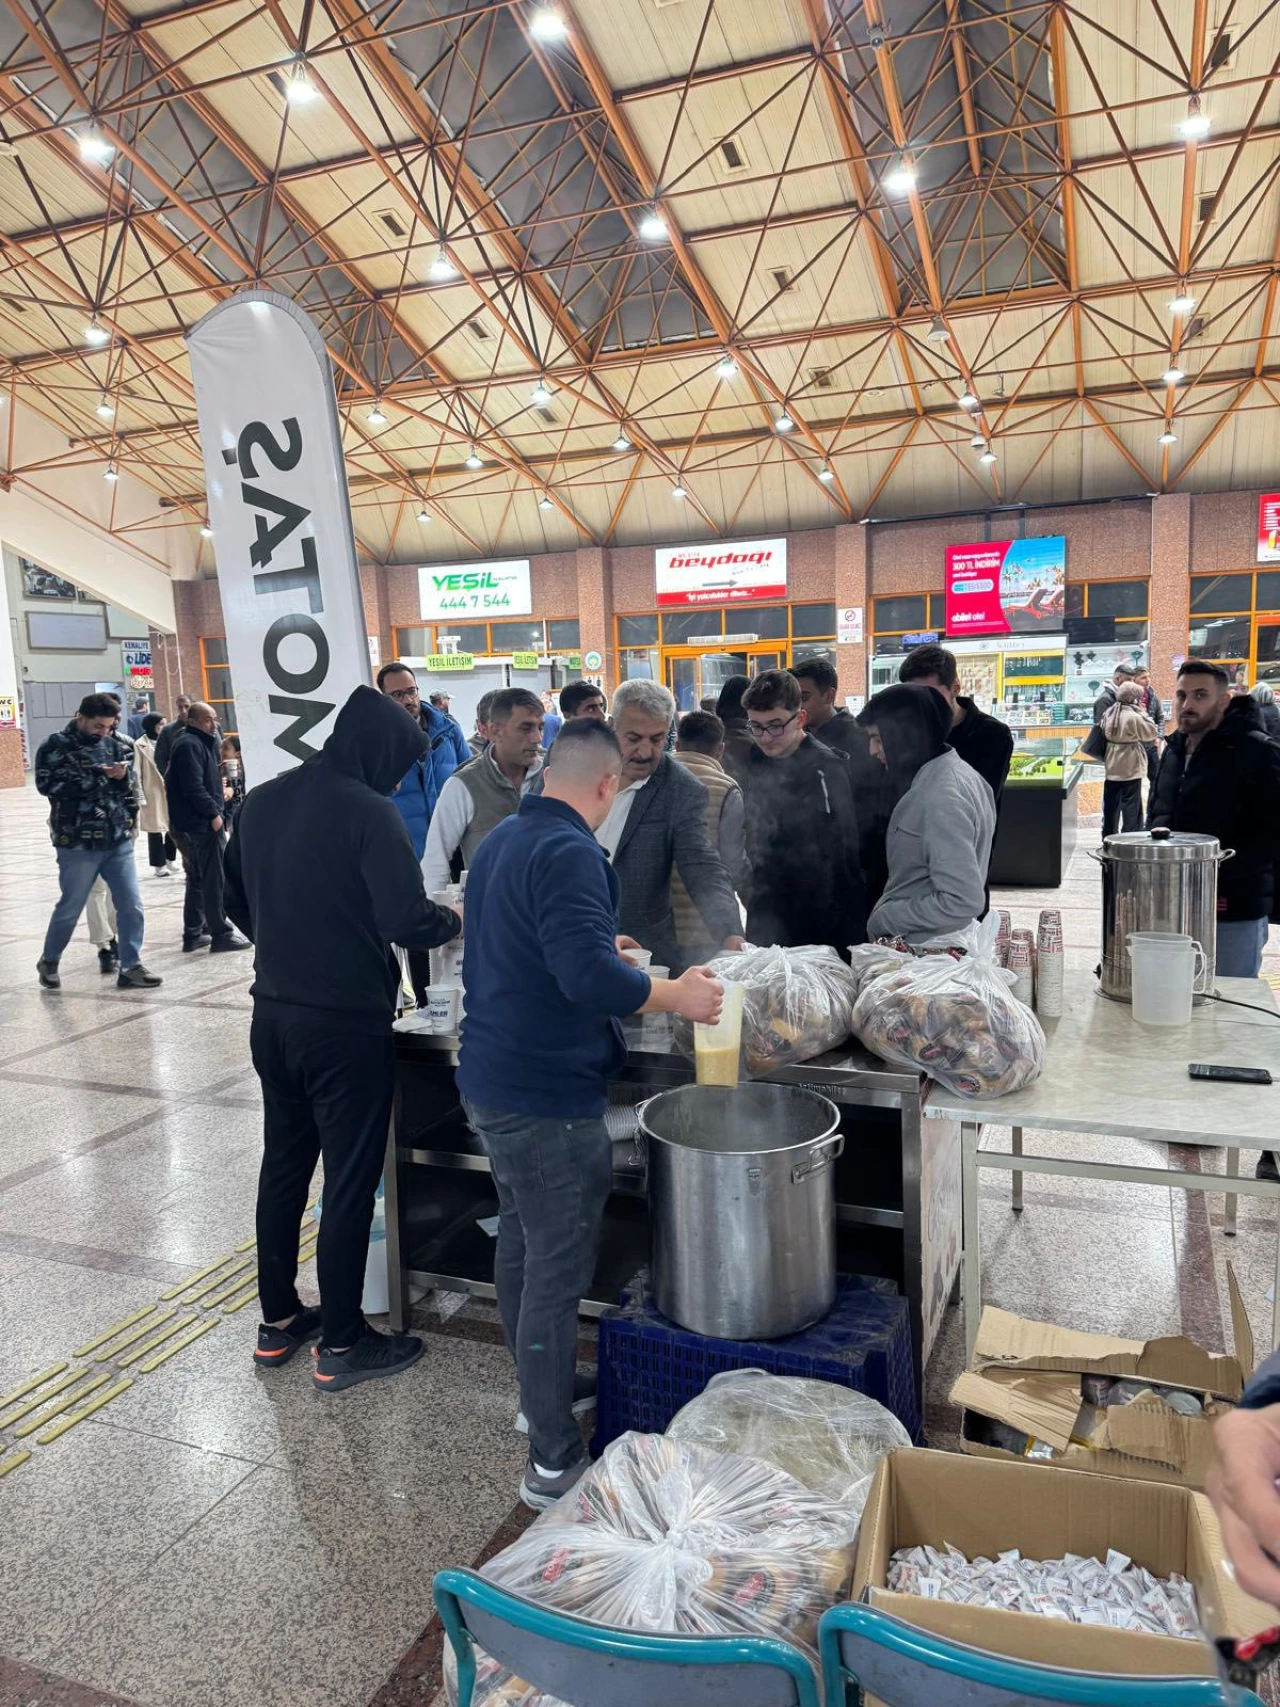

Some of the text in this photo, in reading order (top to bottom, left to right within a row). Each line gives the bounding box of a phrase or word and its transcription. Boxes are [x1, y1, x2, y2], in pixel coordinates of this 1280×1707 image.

[440, 593, 511, 609] 444 7 544
